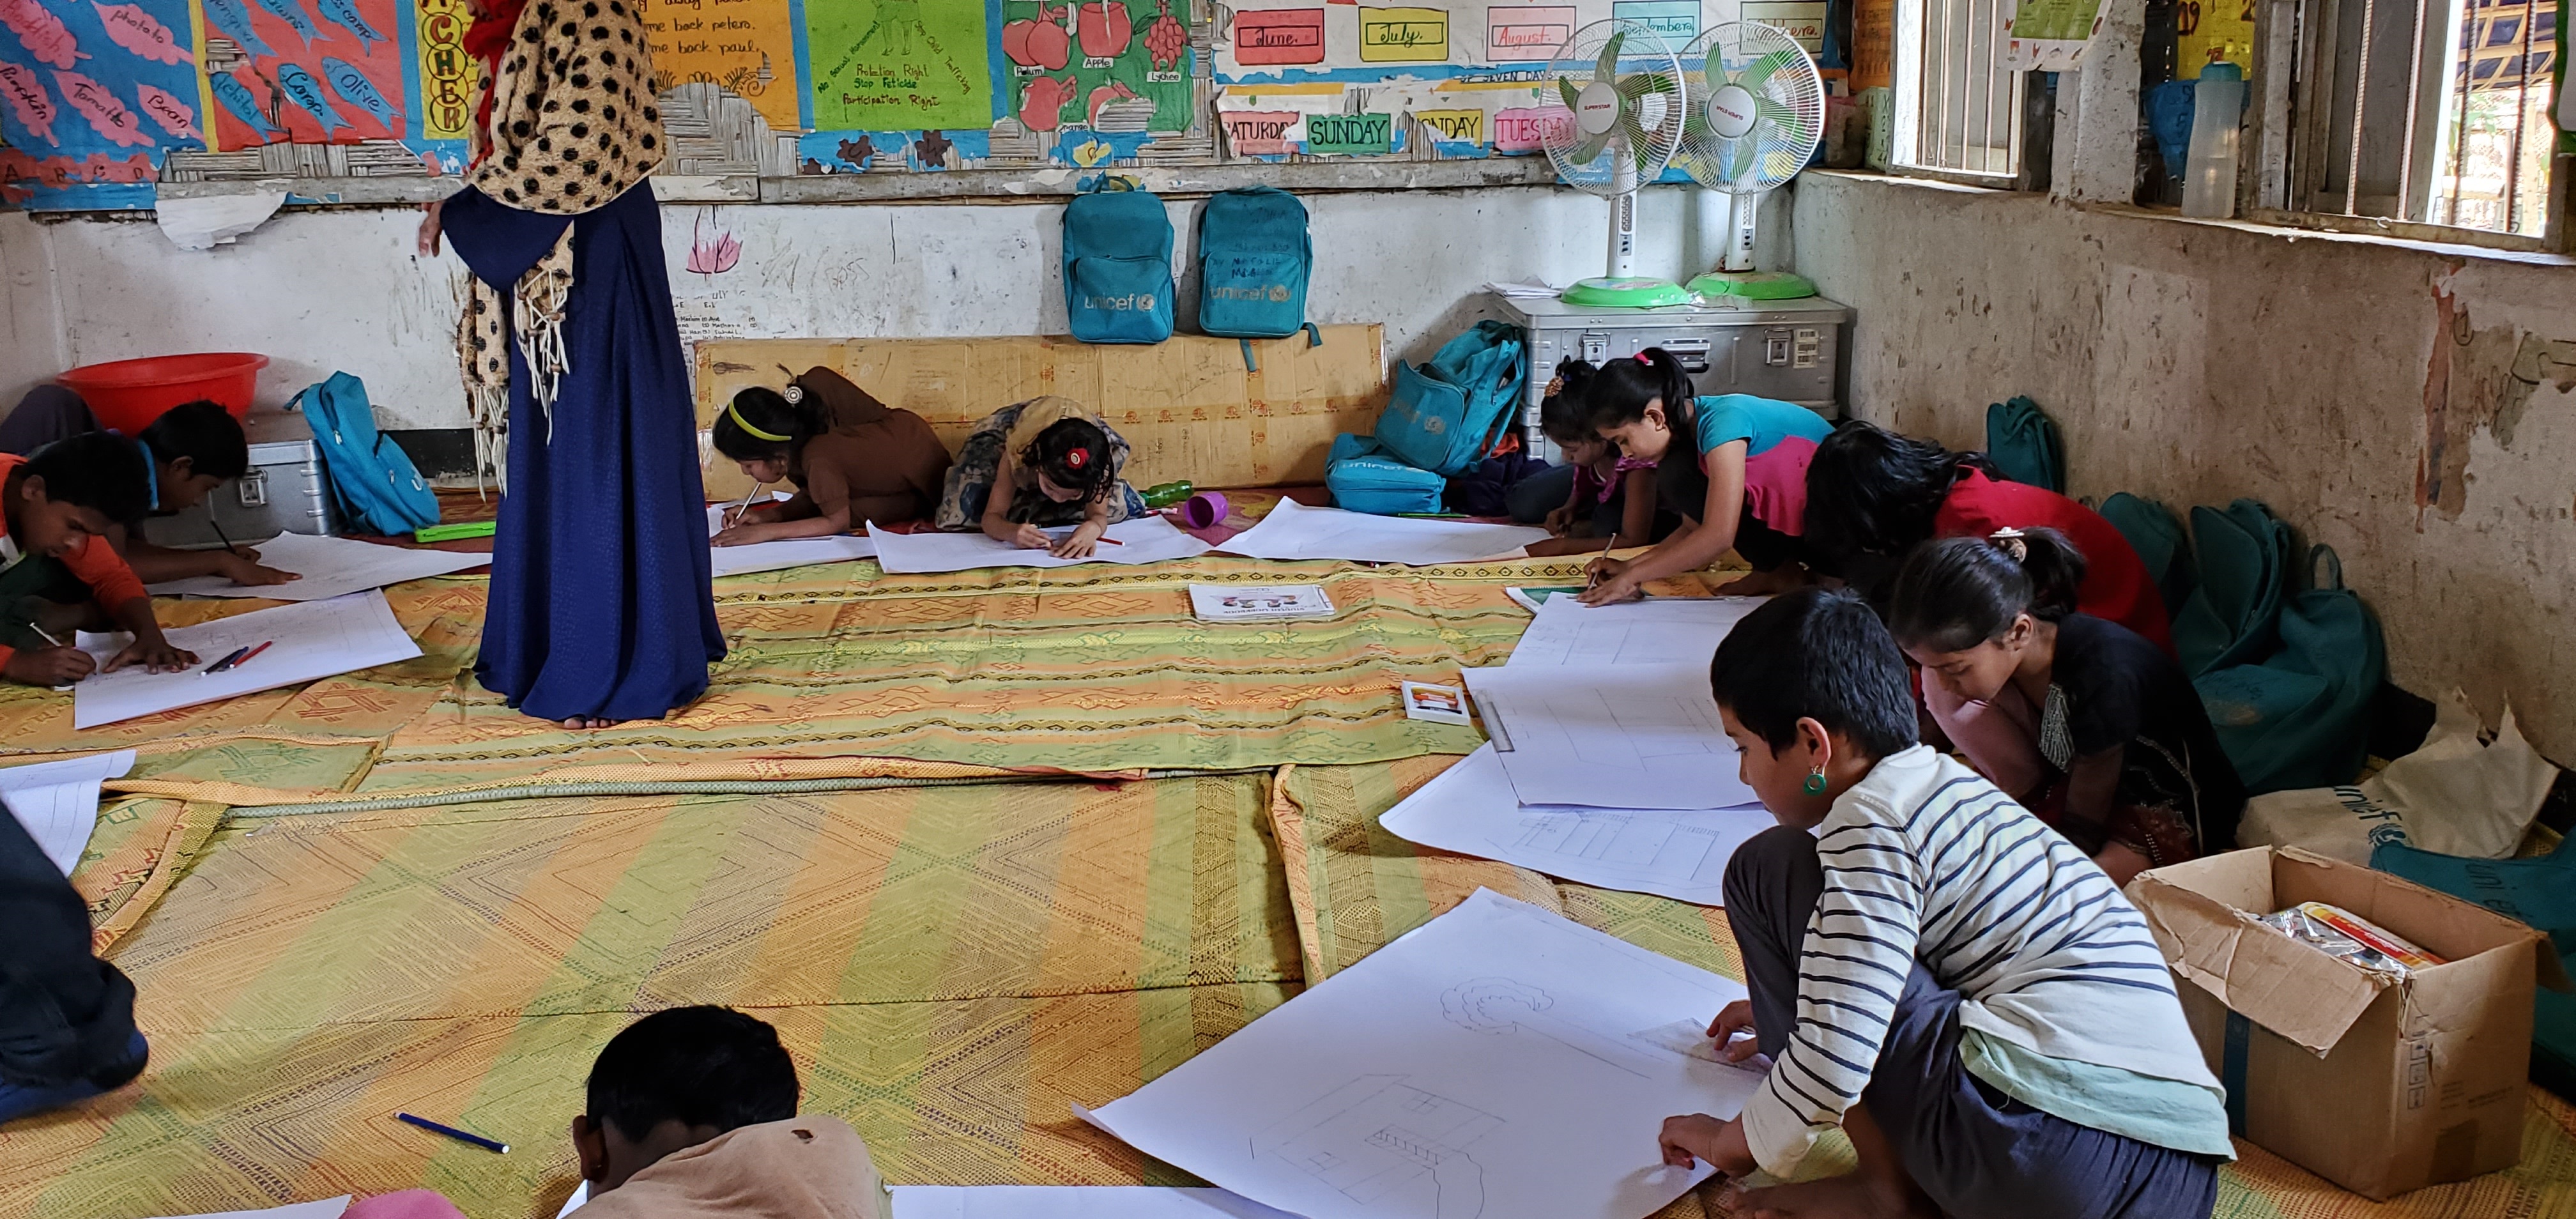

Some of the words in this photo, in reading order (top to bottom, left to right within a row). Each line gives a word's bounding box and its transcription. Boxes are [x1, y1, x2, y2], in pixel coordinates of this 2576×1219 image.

[674, 17, 703, 31] back
[678, 40, 709, 54] back
[1085, 58, 1112, 68] Apple
[903, 63, 930, 81] Right
[1151, 72, 1180, 81] Lychee
[341, 73, 379, 112] Olive
[1310, 120, 1388, 145] SUNDAY
[1209, 284, 1268, 301] unicef
[1084, 293, 1135, 310] unicef
